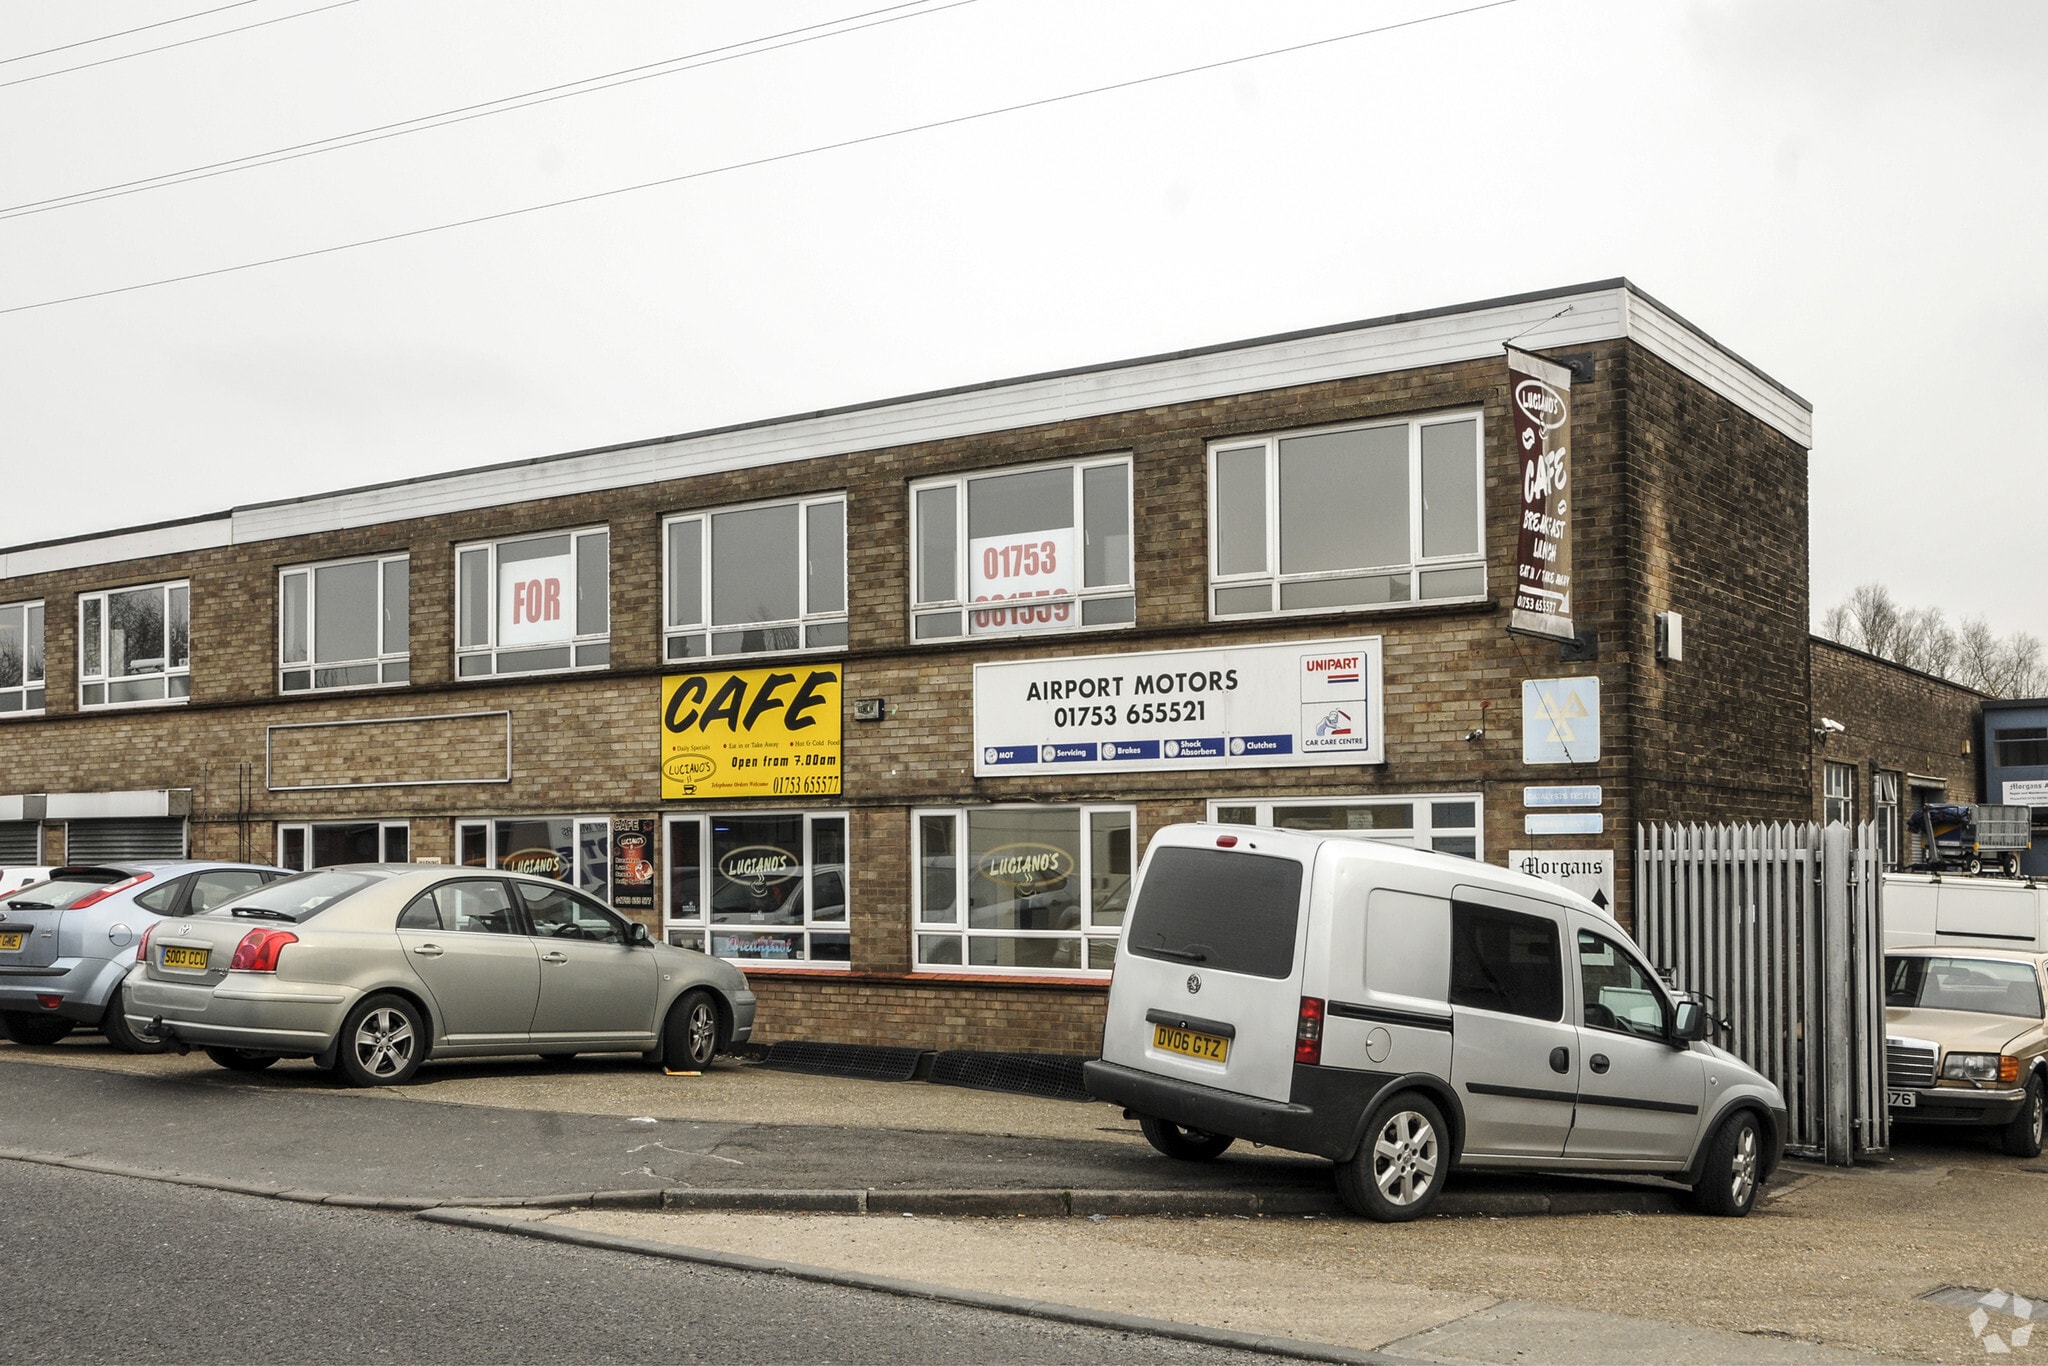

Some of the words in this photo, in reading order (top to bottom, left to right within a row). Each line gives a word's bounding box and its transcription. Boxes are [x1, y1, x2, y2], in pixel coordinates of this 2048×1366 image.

[1522, 390, 1558, 415] LUCIANO'S
[1524, 447, 1567, 503] CAFE
[1533, 537, 1557, 562] LUNCH
[983, 541, 1056, 580] 01753
[513, 578, 560, 625] FOR
[1516, 595, 1534, 610] 01753
[1306, 657, 1359, 672] UNIPART
[1026, 677, 1124, 701] AIRPORT
[1134, 669, 1239, 695] MOTORS
[664, 671, 838, 734] CAFE
[1054, 704, 1117, 728] 01753
[1126, 700, 1205, 725] 655521
[677, 745, 690, 753] Daily
[1180, 740, 1201, 748] Shock
[1247, 741, 1277, 750] Clutches
[1320, 738, 1337, 746] CARE
[1338, 737, 1363, 745] CENTRE
[1057, 749, 1086, 758] Servicing
[1117, 747, 1141, 755] Brakes
[1180, 748, 1217, 757] Absorbers
[668, 761, 711, 776] LUCIANO'S
[731, 756, 758, 770] Open
[763, 755, 789, 767] from
[794, 754, 836, 766] 7.00am
[773, 777, 801, 794] 01753
[803, 776, 839, 793] 655577
[613, 820, 640, 831] CAFE
[511, 857, 560, 873] LUCIANO'S
[729, 855, 787, 875] LUCIANO'S
[990, 853, 1059, 876] LUCIANO'S
[1519, 857, 1603, 879] Morgans
[726, 935, 792, 956] Breakfast
[189, 951, 206, 965] CCU
[1158, 1028, 1190, 1051] DV06
[1193, 1036, 1221, 1058] GTZ
